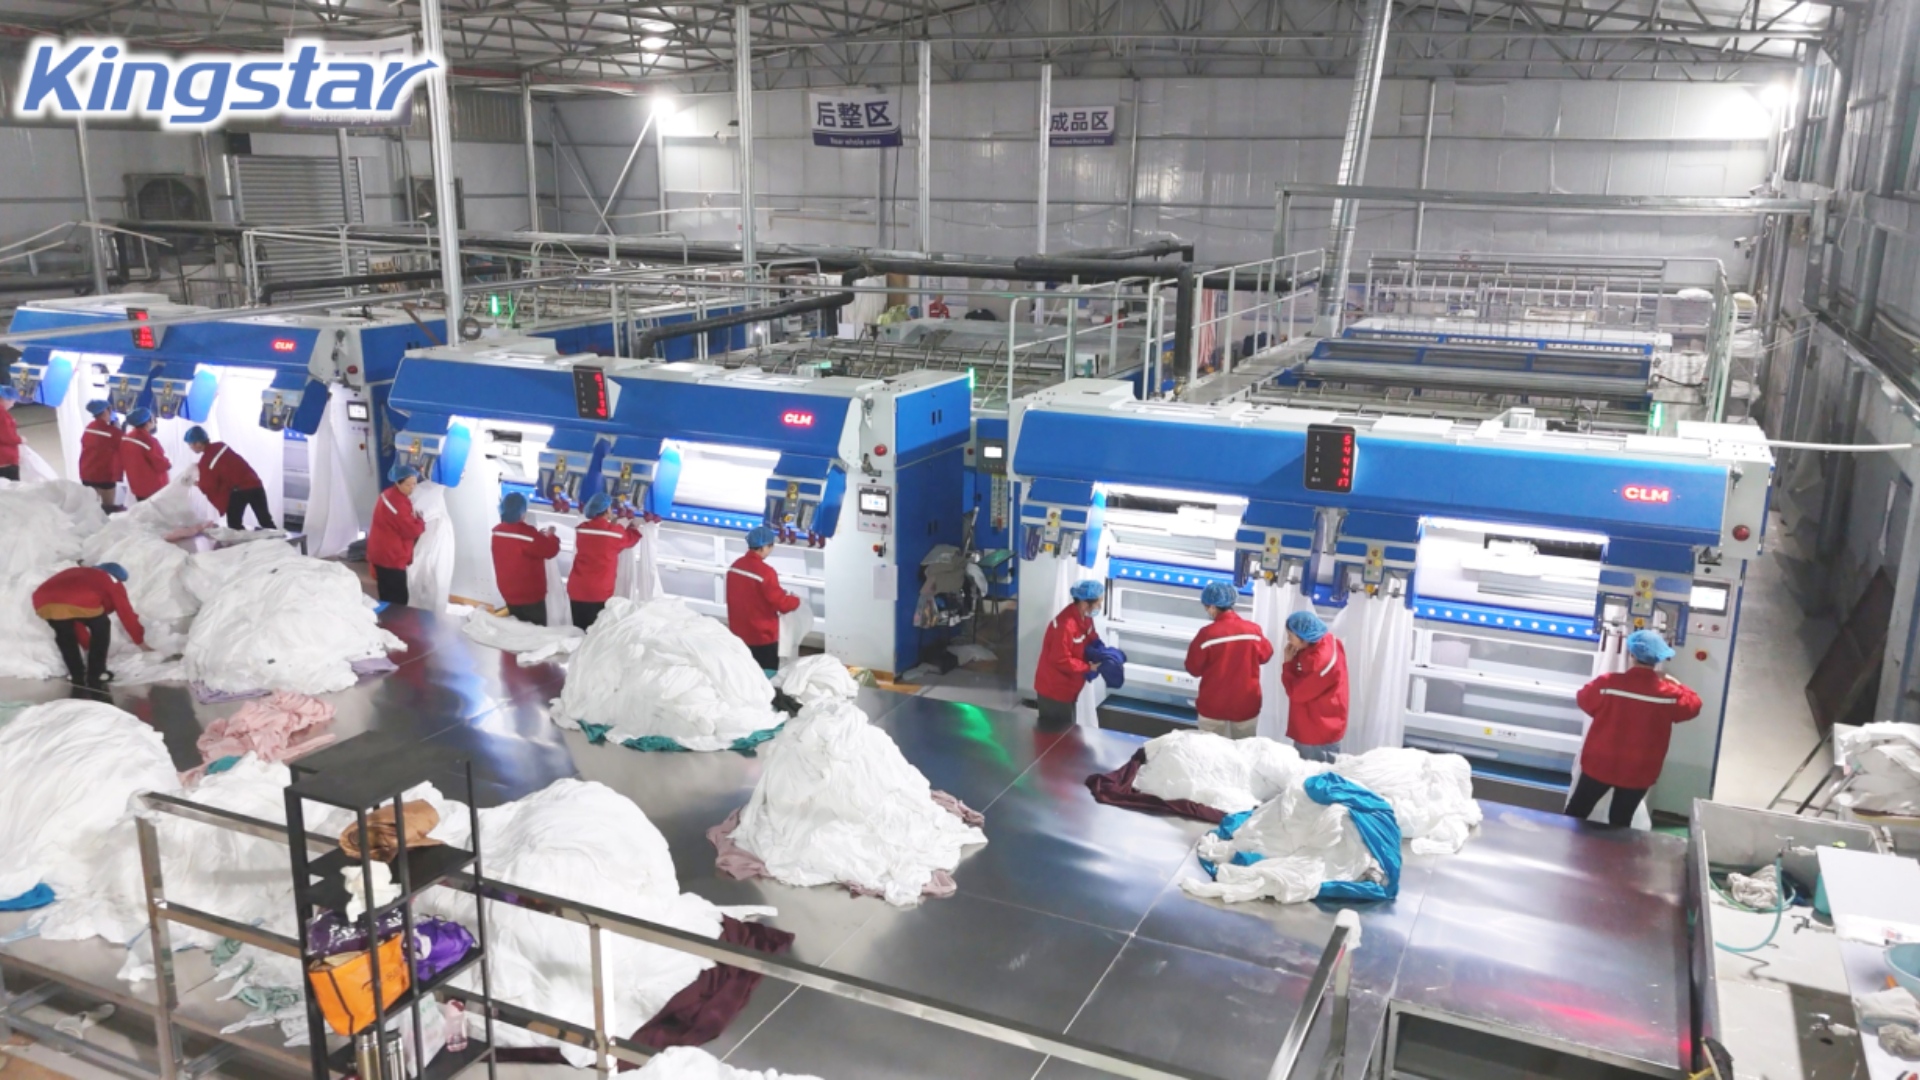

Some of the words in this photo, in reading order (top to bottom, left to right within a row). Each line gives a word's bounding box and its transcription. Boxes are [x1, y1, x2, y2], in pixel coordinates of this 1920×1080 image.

[816, 101, 893, 129] 后整区
[1050, 111, 1109, 131] 成品区
[783, 413, 813, 425] CLM
[1343, 433, 1352, 445] 5
[1624, 486, 1670, 502] CLM
